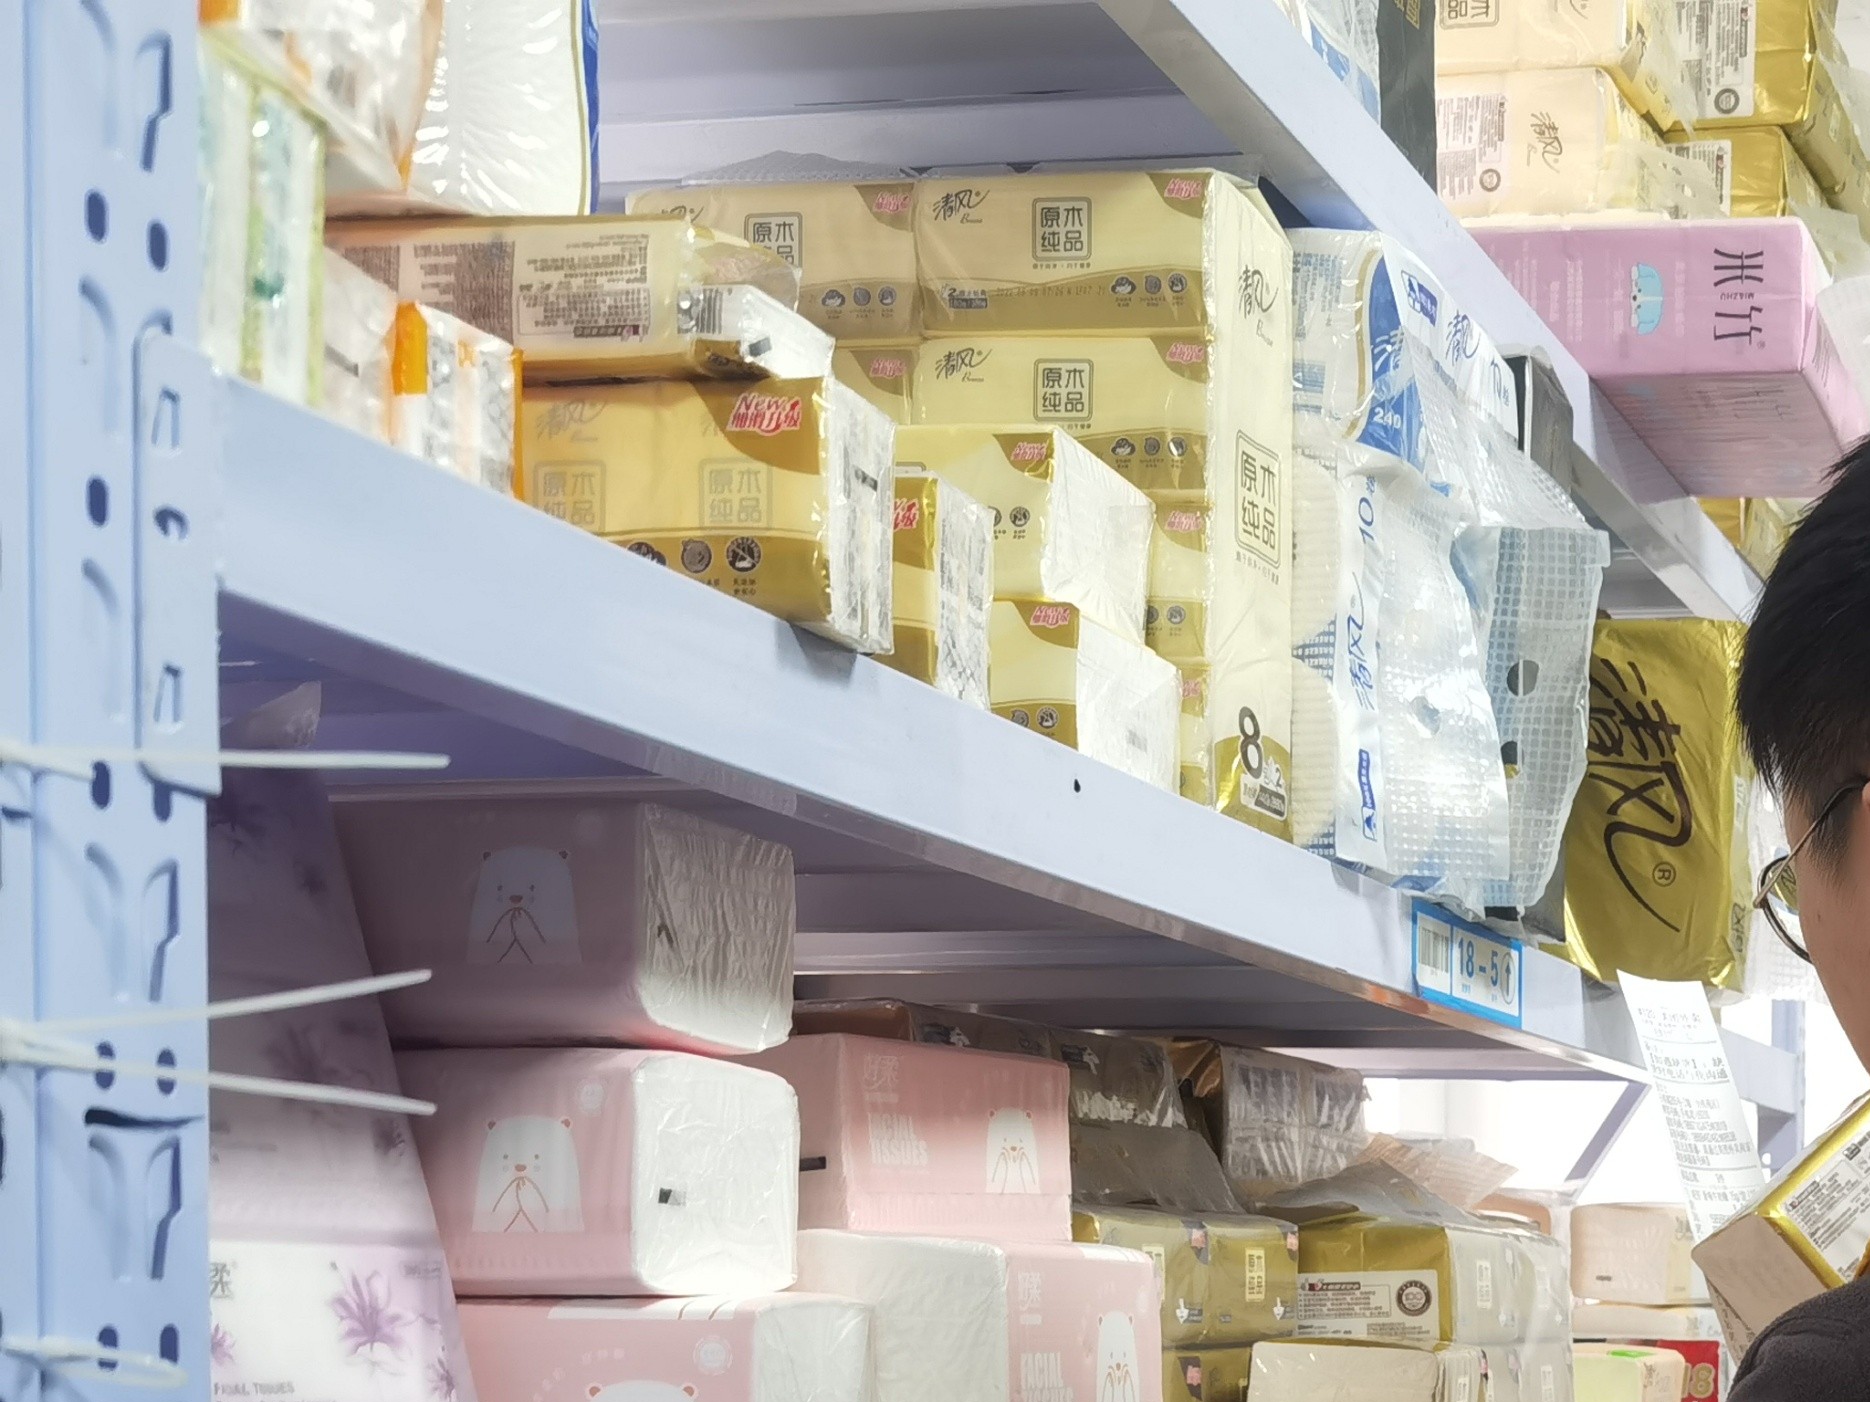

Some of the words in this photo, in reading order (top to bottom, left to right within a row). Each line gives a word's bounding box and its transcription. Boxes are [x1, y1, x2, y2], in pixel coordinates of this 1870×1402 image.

[932, 189, 990, 221] 清风
[1041, 207, 1083, 228] 原木
[753, 221, 794, 243] 原木
[1041, 231, 1083, 252] 纯品
[935, 347, 992, 379] 清风
[1042, 367, 1084, 388] 原木
[1042, 392, 1084, 413] 纯品
[709, 469, 761, 494] 原木
[1241, 451, 1276, 506] 原木
[709, 497, 761, 523] 纯品
[1241, 496, 1275, 550] 纯品
[1239, 706, 1262, 779] 8
[1589, 659, 1692, 932] 清风
[1458, 937, 1499, 988] 18-5
[1021, 1352, 1062, 1388] FACIAL
